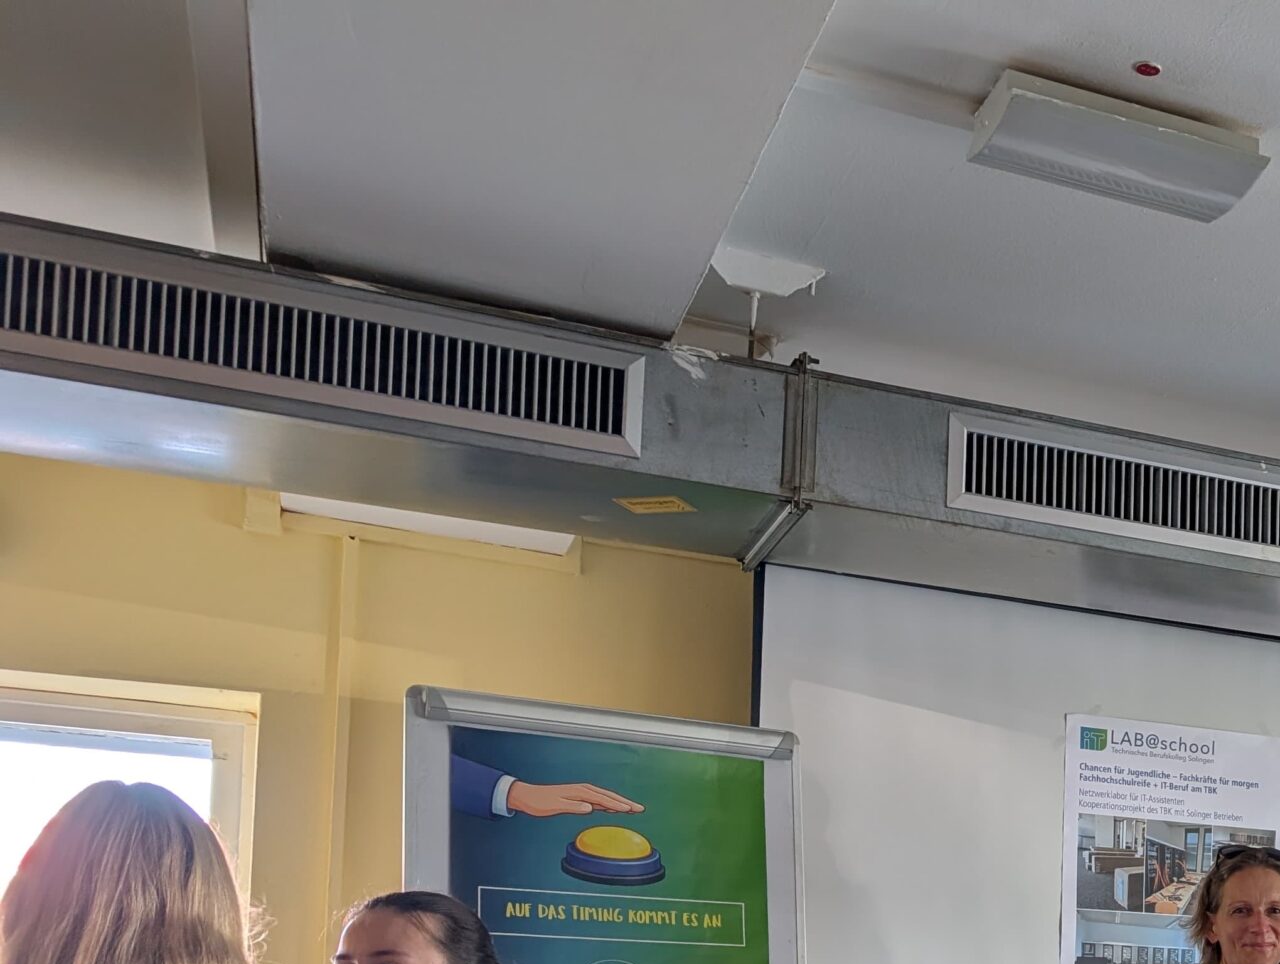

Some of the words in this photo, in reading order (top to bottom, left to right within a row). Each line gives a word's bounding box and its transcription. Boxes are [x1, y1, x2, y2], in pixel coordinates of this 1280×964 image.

[1111, 730, 1215, 755] LAB@school
[1111, 747, 1148, 758] Technisches
[1149, 750, 1187, 763] Berufskolleg
[1188, 755, 1215, 765] Solingen
[1080, 762, 1112, 773] Chancen
[1114, 765, 1125, 775] für
[1127, 768, 1171, 779] Jugendliche
[1179, 773, 1218, 785] Fachkräfte
[1219, 777, 1230, 786] für
[1231, 780, 1260, 790] morgen
[1080, 773, 1151, 788] Fachhochschulreife
[1160, 781, 1189, 792] IT-Beruf
[1191, 785, 1202, 793] am
[1204, 786, 1218, 795] TBK
[1079, 788, 1127, 800] Netzwerklabor
[1129, 792, 1139, 801] für
[1140, 793, 1185, 806] IT-Assistenten
[1078, 799, 1145, 814] Kooperationsprojekt
[1146, 805, 1158, 813] des
[1160, 806, 1173, 815] TBK
[1174, 808, 1185, 817] mit
[1186, 808, 1213, 821] Solinger
[1213, 811, 1244, 822] Betrieben
[506, 902, 531, 917] AUF
[538, 904, 566, 920] DAS
[571, 905, 623, 922] TIMING
[628, 910, 677, 925] KOMMT
[682, 913, 699, 927] ES
[703, 914, 722, 928] AN
